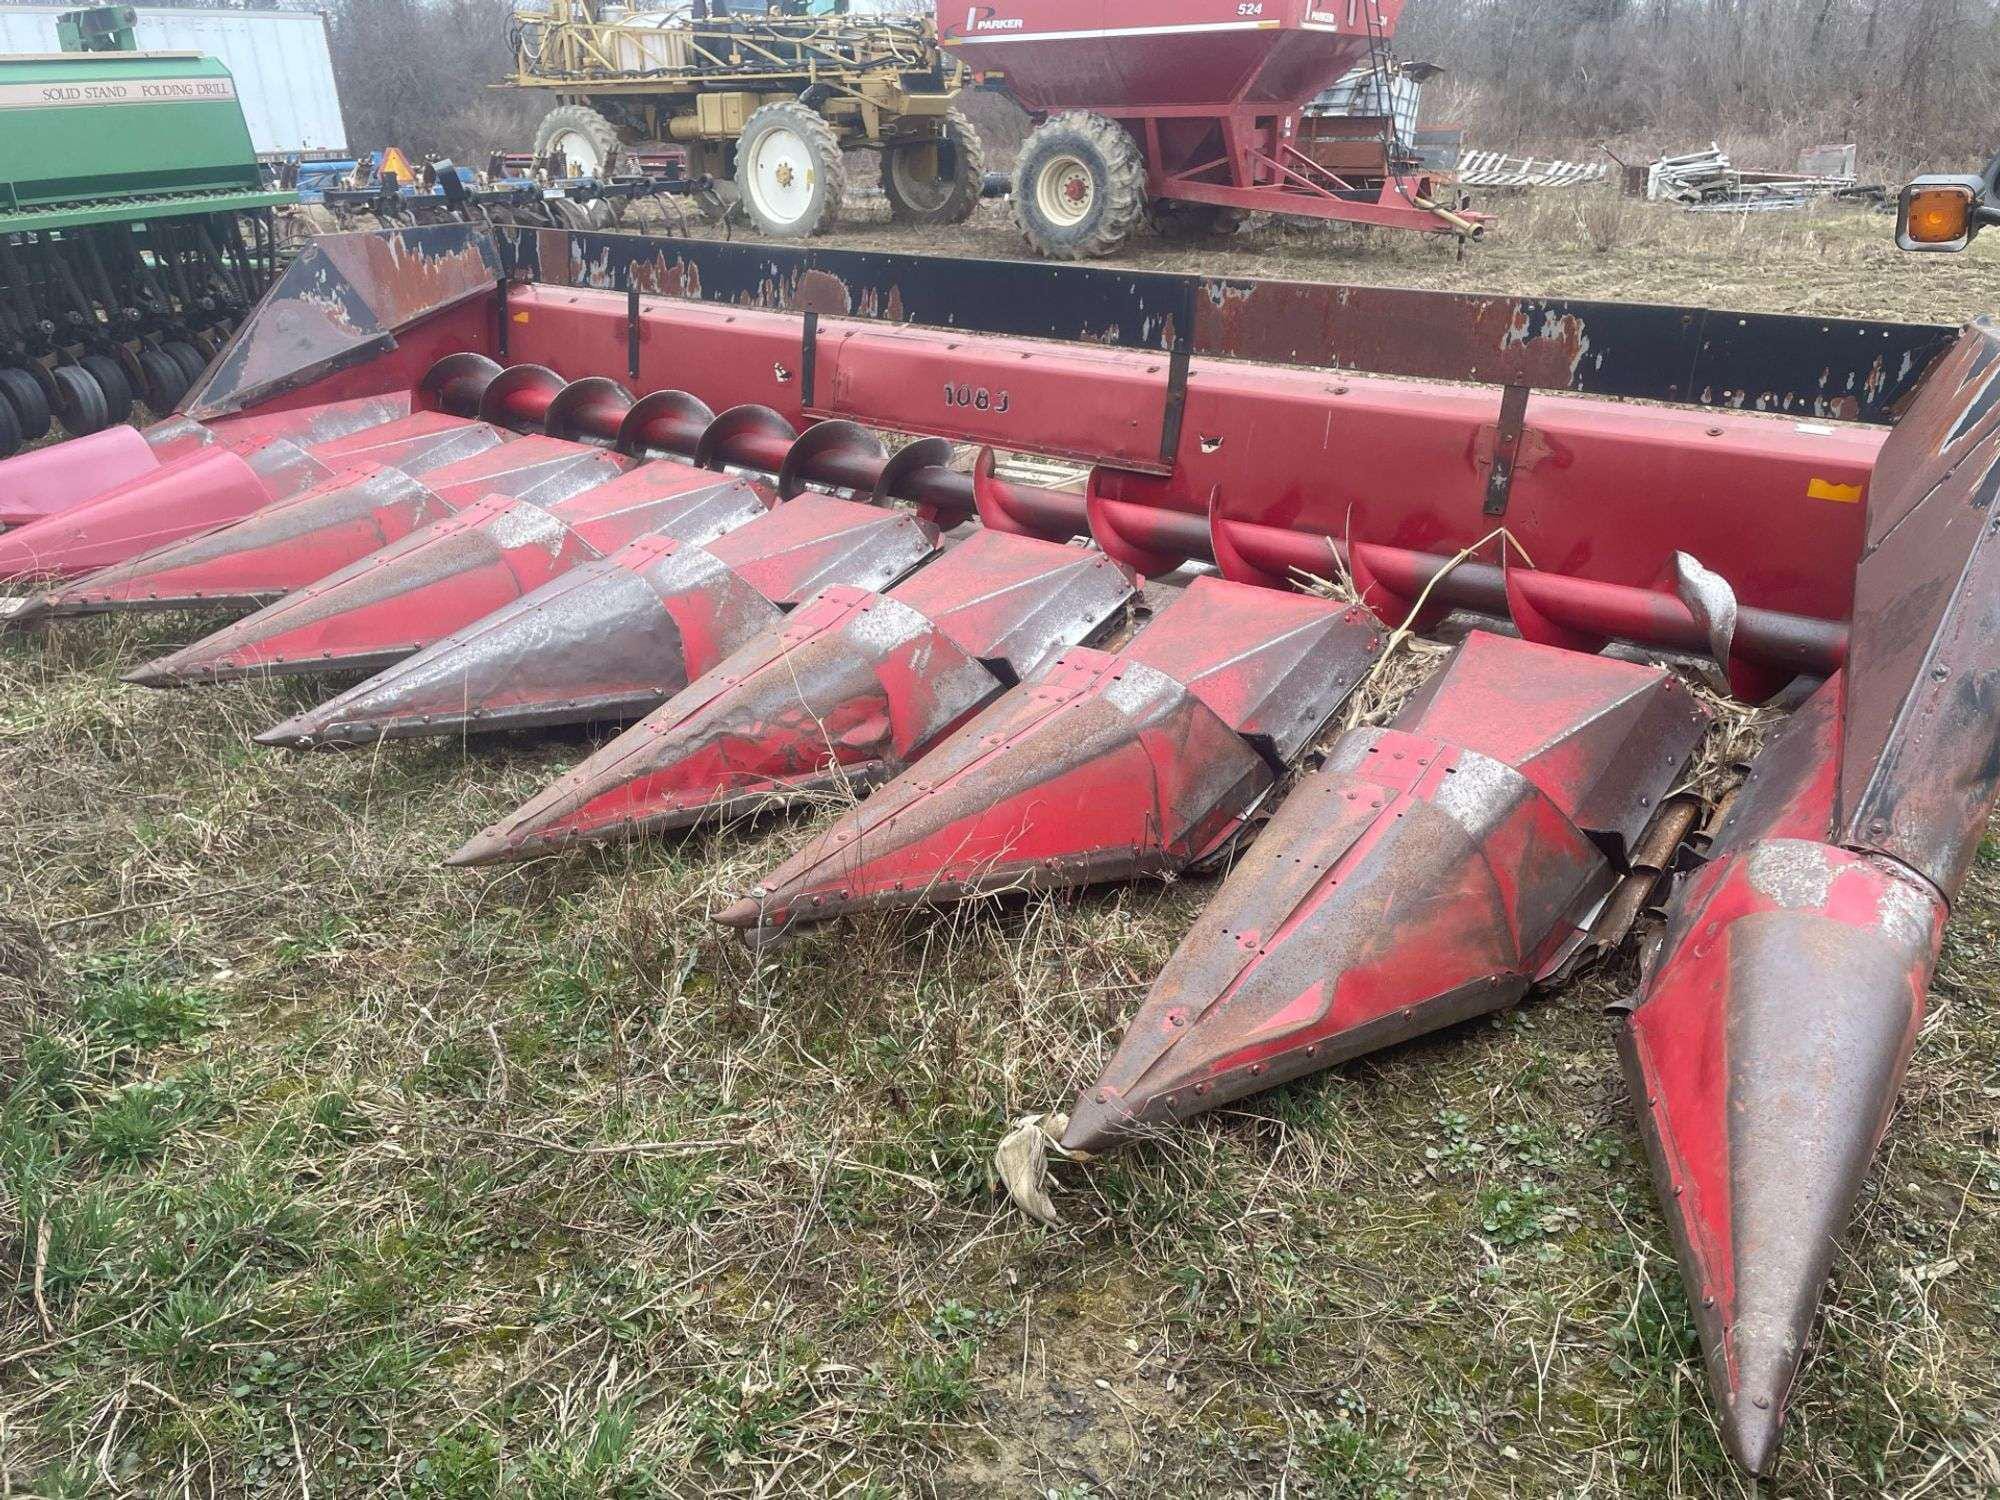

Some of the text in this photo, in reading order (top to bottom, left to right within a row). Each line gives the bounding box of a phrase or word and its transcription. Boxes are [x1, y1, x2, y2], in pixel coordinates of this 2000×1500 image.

[1237, 3, 1263, 15] 524
[977, 18, 1023, 30] PARKER
[42, 83, 229, 100] SOLID STAND FOLDING DRILL
